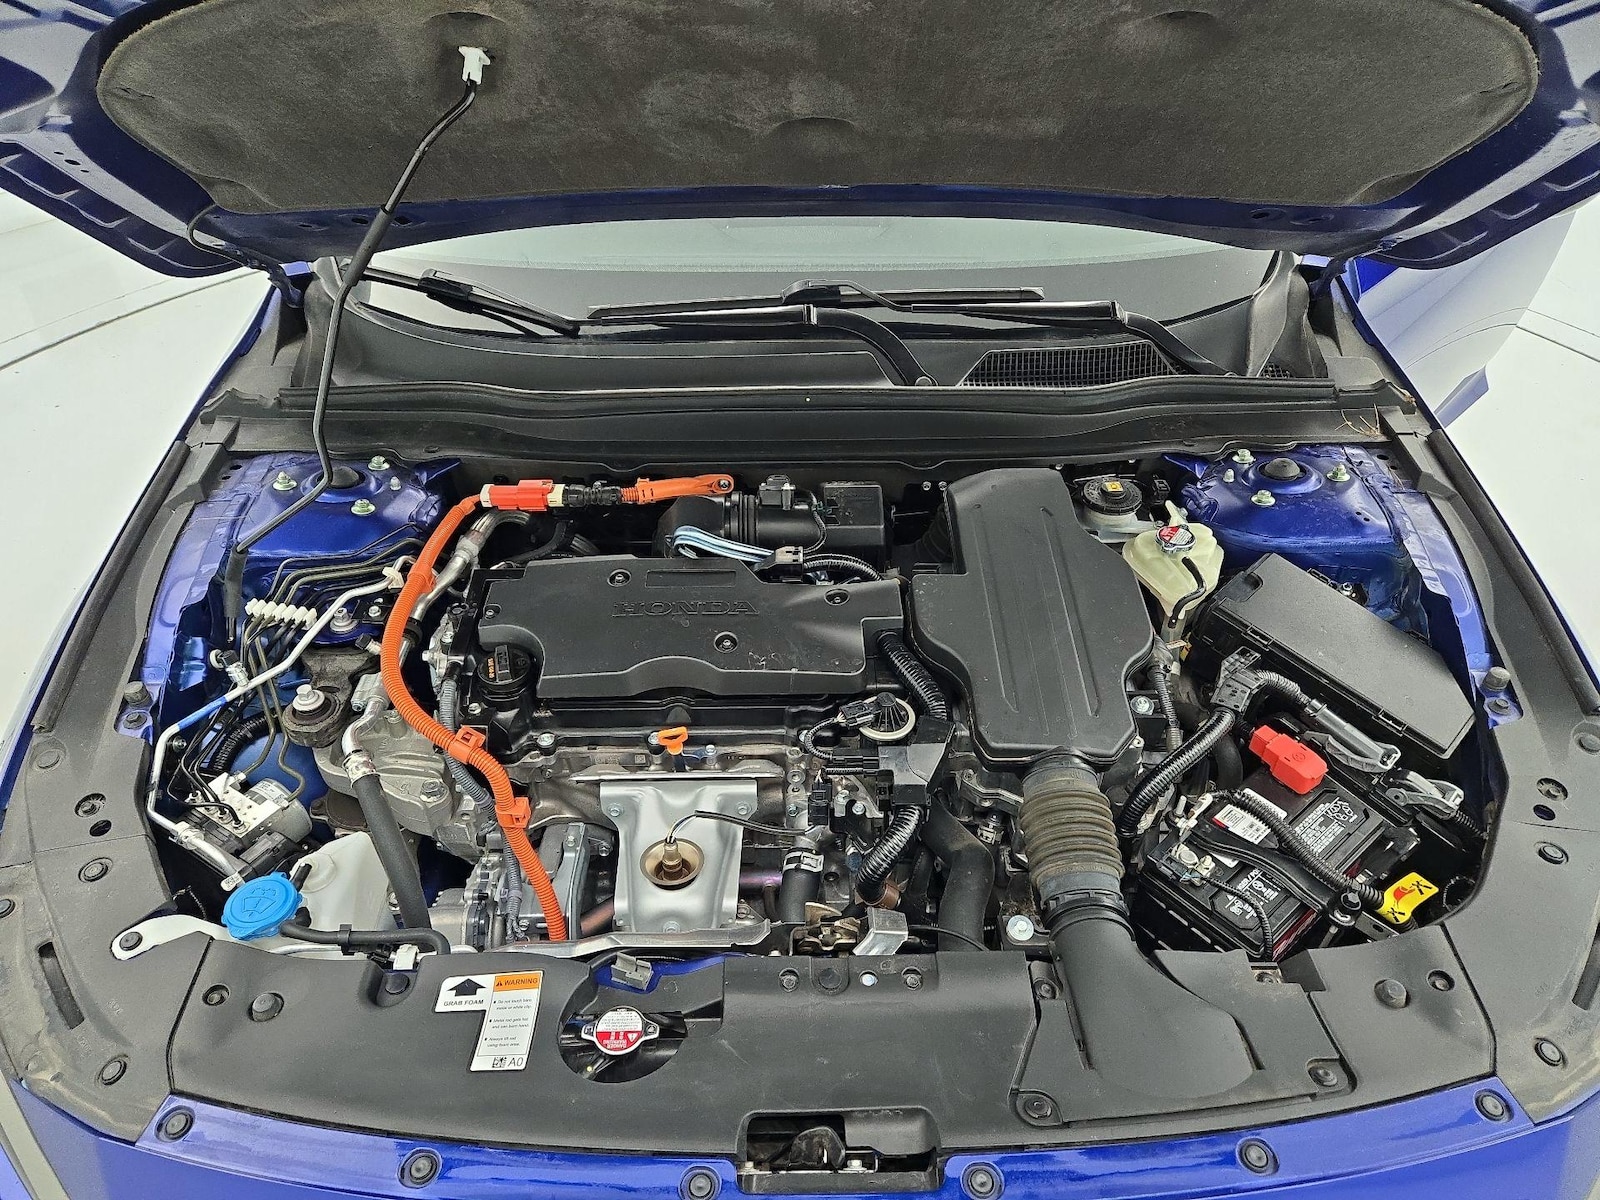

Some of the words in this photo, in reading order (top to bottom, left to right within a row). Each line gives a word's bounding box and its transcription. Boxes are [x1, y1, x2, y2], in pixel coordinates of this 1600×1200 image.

[612, 600, 760, 617] HONDA
[504, 978, 538, 986] WARNING
[508, 1057, 524, 1067] A0
